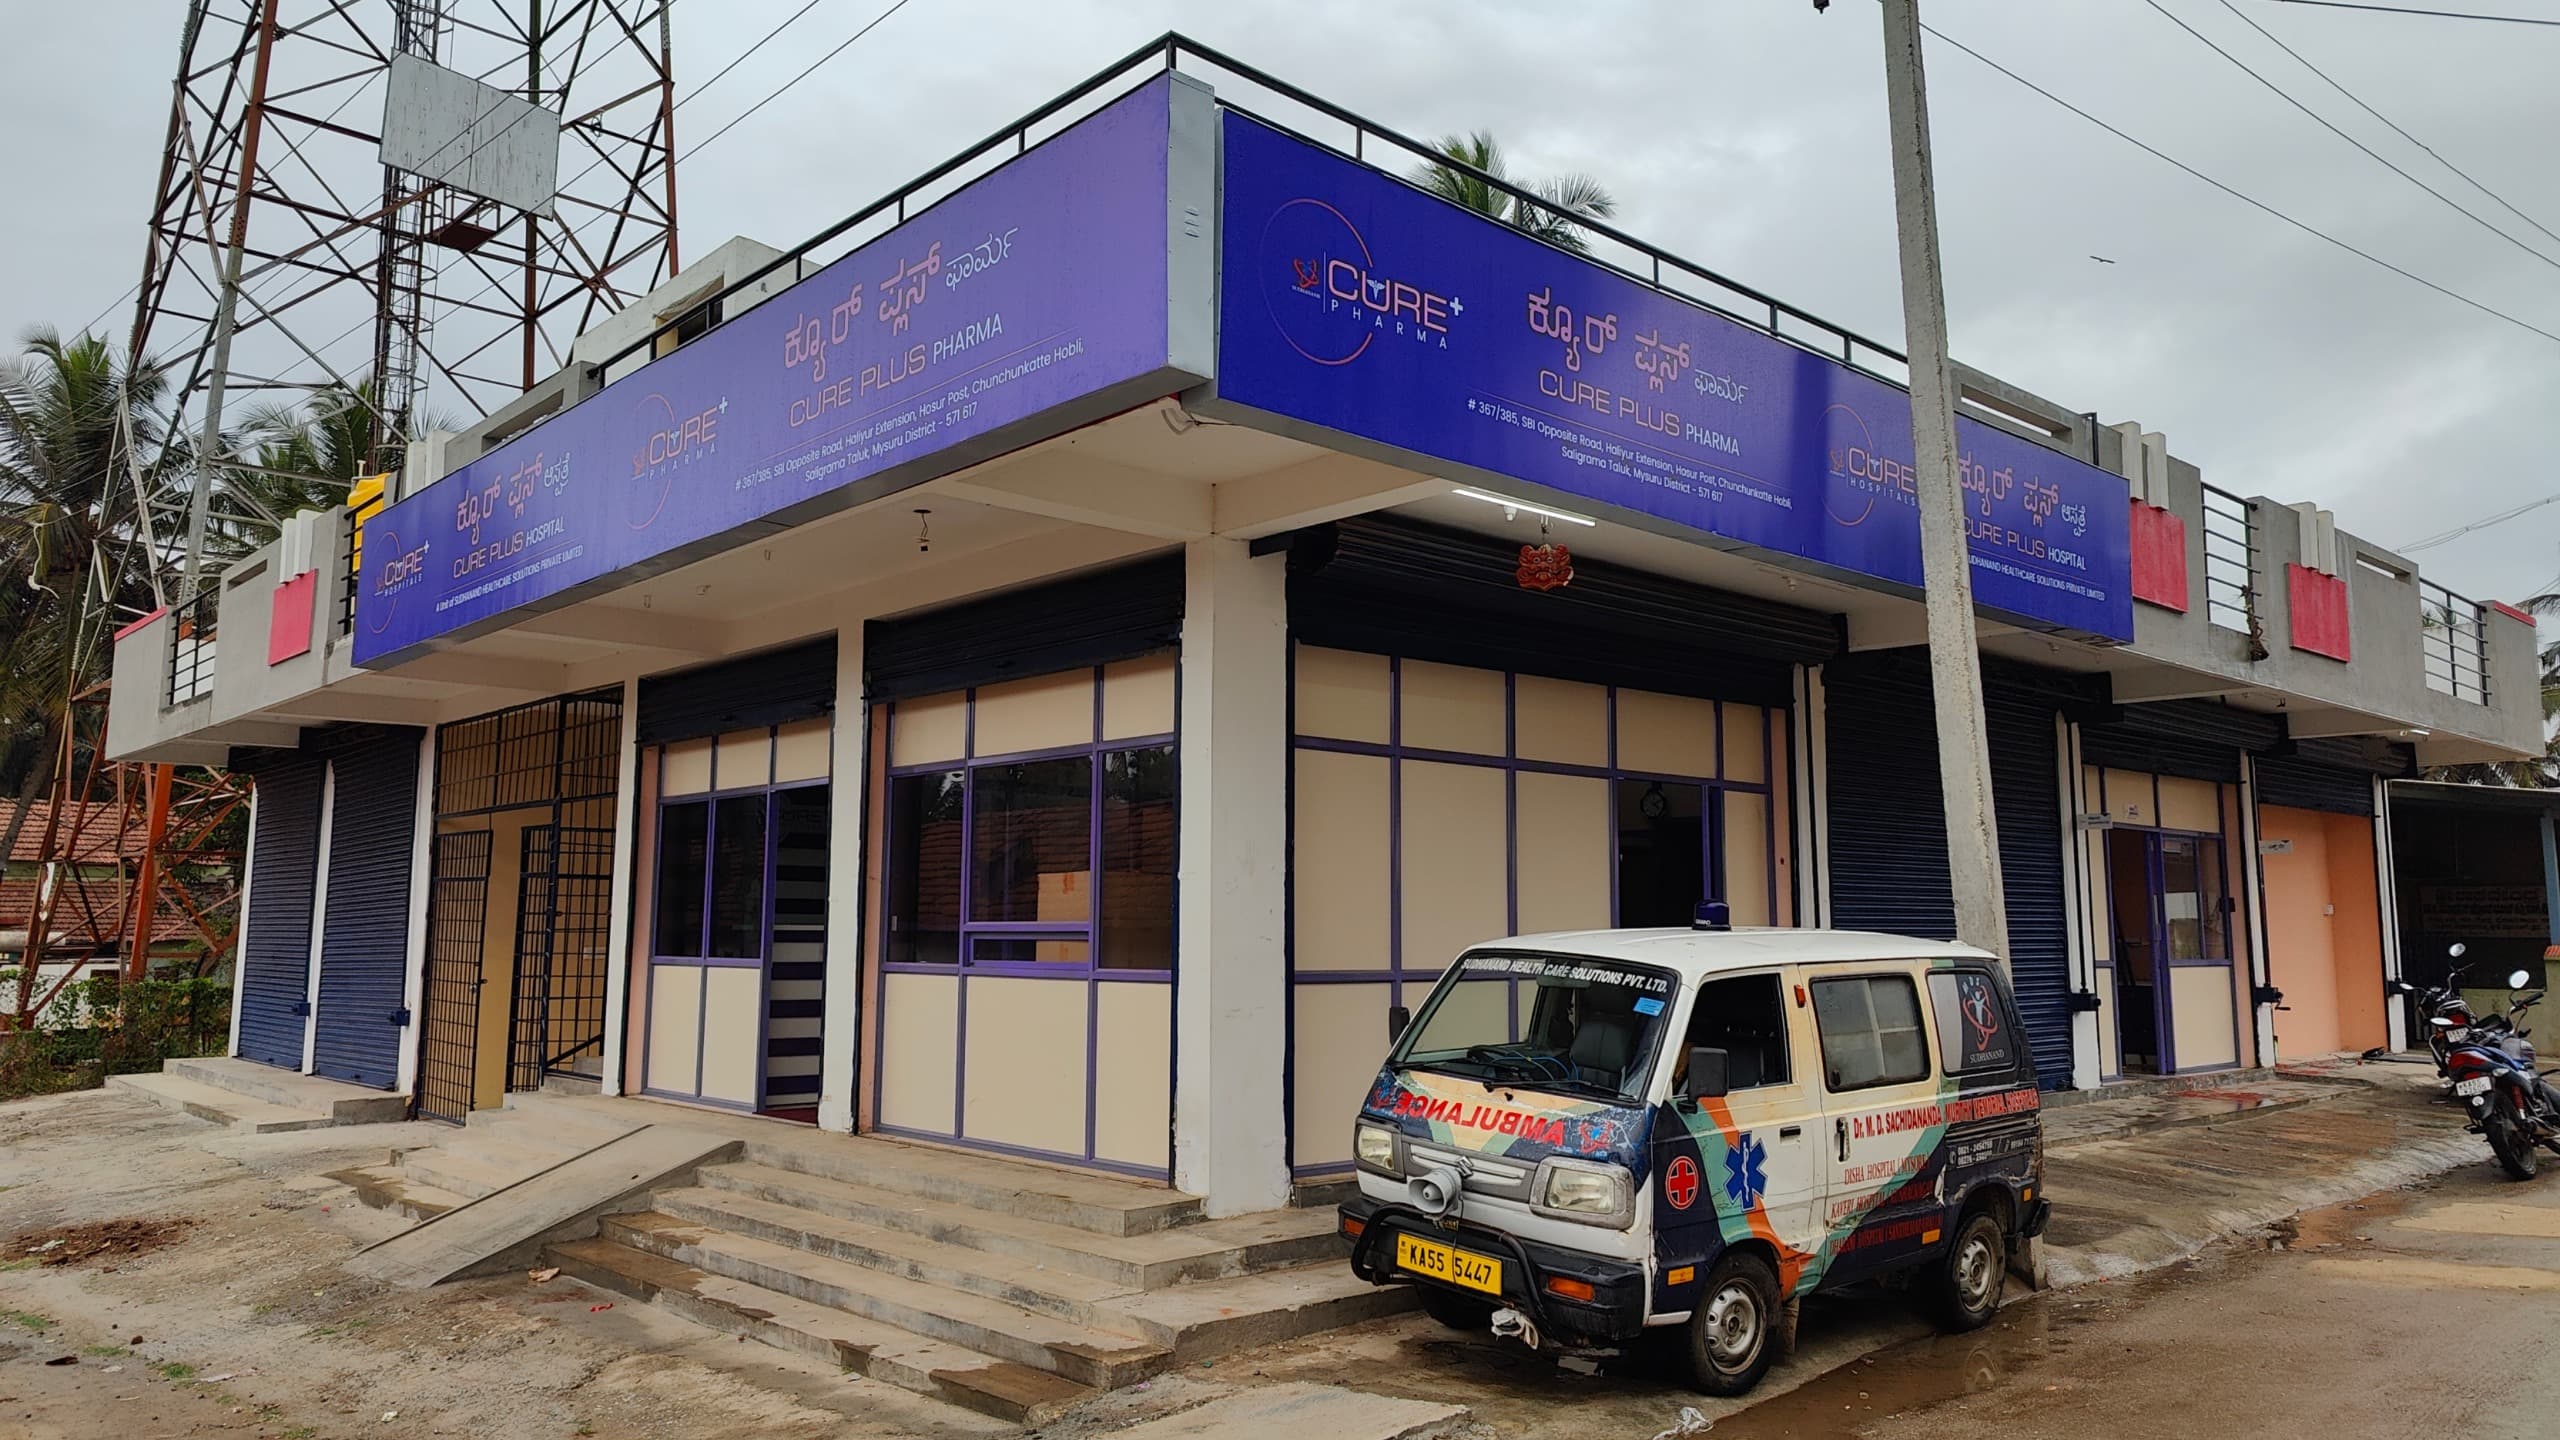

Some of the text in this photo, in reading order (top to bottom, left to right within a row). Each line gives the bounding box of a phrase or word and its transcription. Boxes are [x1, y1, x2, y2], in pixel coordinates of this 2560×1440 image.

[1331, 299, 1447, 349] PHARMA
[789, 313, 1004, 428] CURE PLUS PHARMA
[786, 448, 820, 473] Opposite
[822, 438, 843, 457] Road,
[845, 427, 873, 447] Haliyur
[875, 410, 917, 436] Extension,
[919, 396, 945, 418] Hosur
[947, 387, 970, 406] Post,
[972, 354, 1051, 394] Chunchunkatte
[1053, 337, 1084, 363] Hobli,
[1539, 370, 1741, 457] CURE PLUS PHARMA
[650, 442, 716, 480] PHARMA
[804, 457, 846, 483] Saligrama
[872, 437, 903, 458] Mysuru
[905, 421, 937, 444] District
[945, 409, 960, 427] 571
[962, 402, 977, 420] 617
[1467, 399, 1476, 411] #
[1478, 402, 1520, 427] 367/385,
[1521, 415, 1536, 431] SBI
[1537, 421, 1578, 444] Opposite
[1579, 434, 1604, 453] Road,
[1605, 442, 1634, 461] Haliyur
[1636, 452, 1674, 475] Extension,
[1676, 463, 1698, 481] Hosur
[1561, 446, 1606, 469] Saligrama
[1608, 459, 1632, 478] Taluk,
[1633, 467, 1663, 487] Mysuru
[1664, 478, 1691, 495] District
[1698, 486, 1710, 499] 571
[1711, 490, 1724, 503] 617
[1850, 476, 1916, 506] HOSPITALS
[453, 516, 565, 579] CURE PLUS HOSPITAL
[1968, 554, 2001, 573] UDHANAND
[2007, 530, 2045, 559] PLUS
[2048, 546, 2087, 571] HOSPITAL
[1461, 958, 1668, 993] SUDHANAND HEALTH CARE SOLUTIONS PVT. LTD.
[1853, 1117, 1865, 1139] Dr.
[1865, 1115, 1875, 1137] M.
[1876, 1114, 1884, 1136] D.
[1885, 1104, 1942, 1134] SACHIDANANDA
[1844, 1164, 1865, 1185] DISHA
[1867, 1160, 1896, 1180] HOSPITAL
[1410, 1243, 1445, 1273] KA55
[1454, 1256, 1492, 1285] 5447
